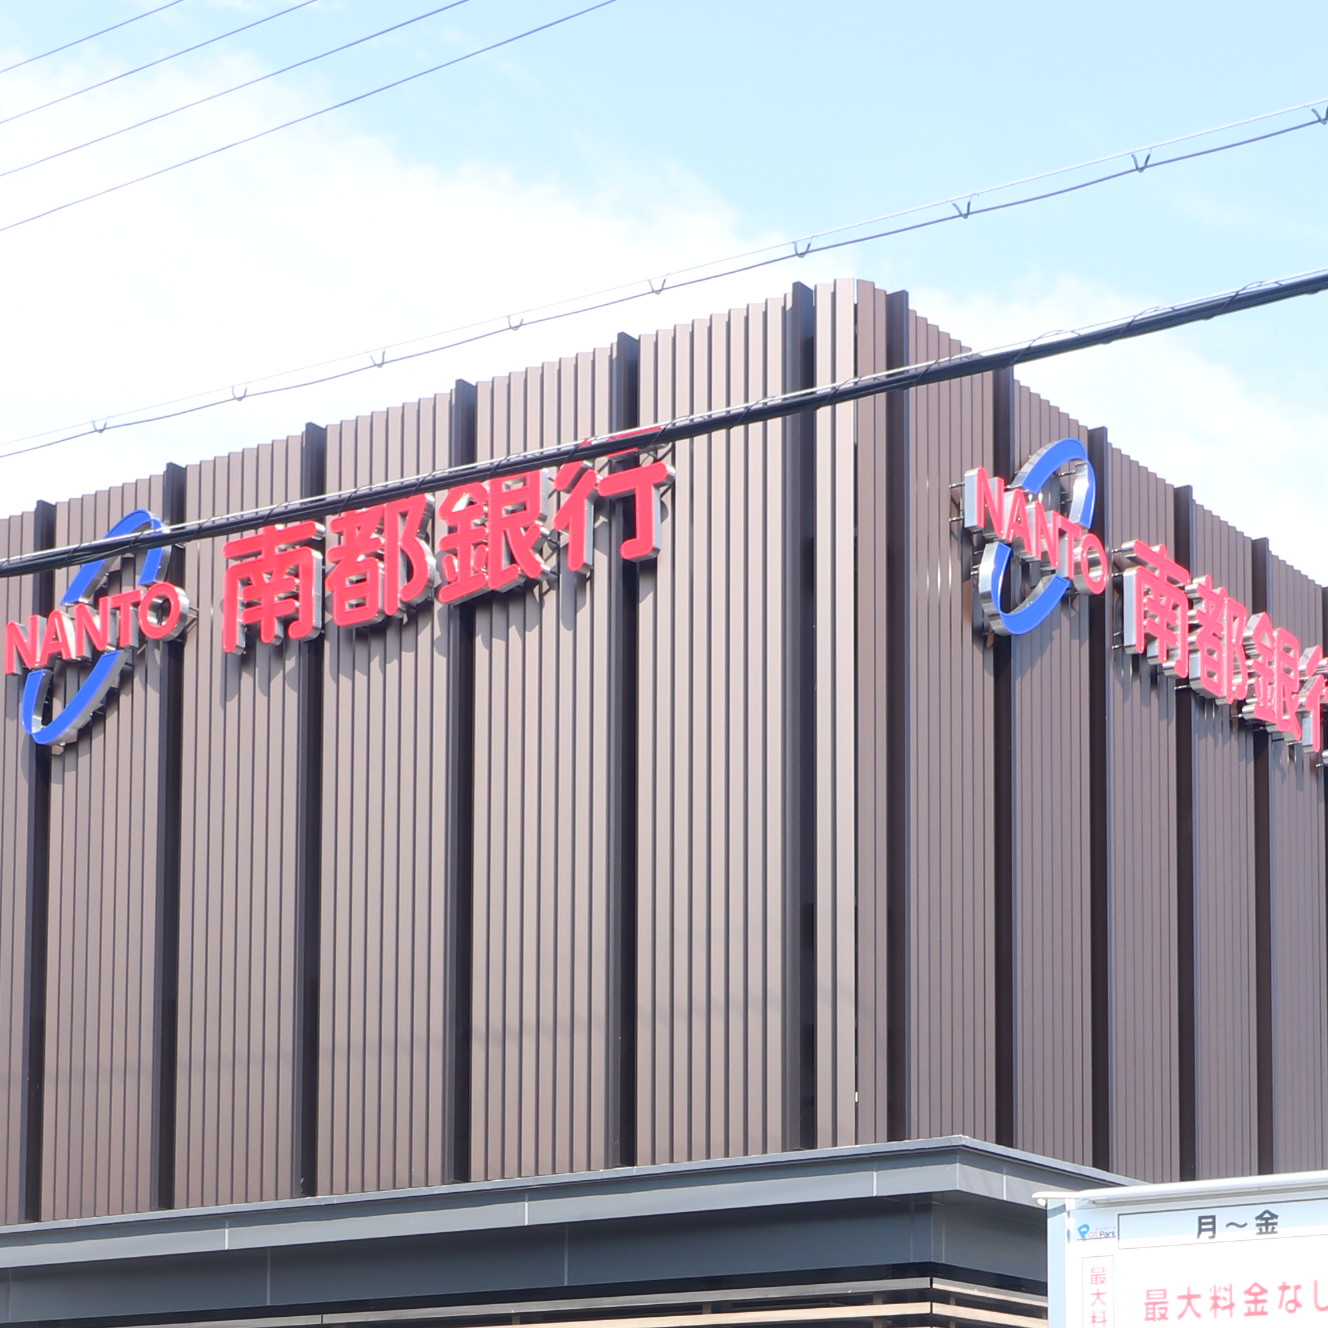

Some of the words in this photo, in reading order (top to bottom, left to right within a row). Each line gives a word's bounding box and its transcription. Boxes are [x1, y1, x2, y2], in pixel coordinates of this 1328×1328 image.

[224, 426, 674, 654] 南都銀行
[967, 466, 1108, 595] NANTO
[5, 583, 187, 676] NANTO
